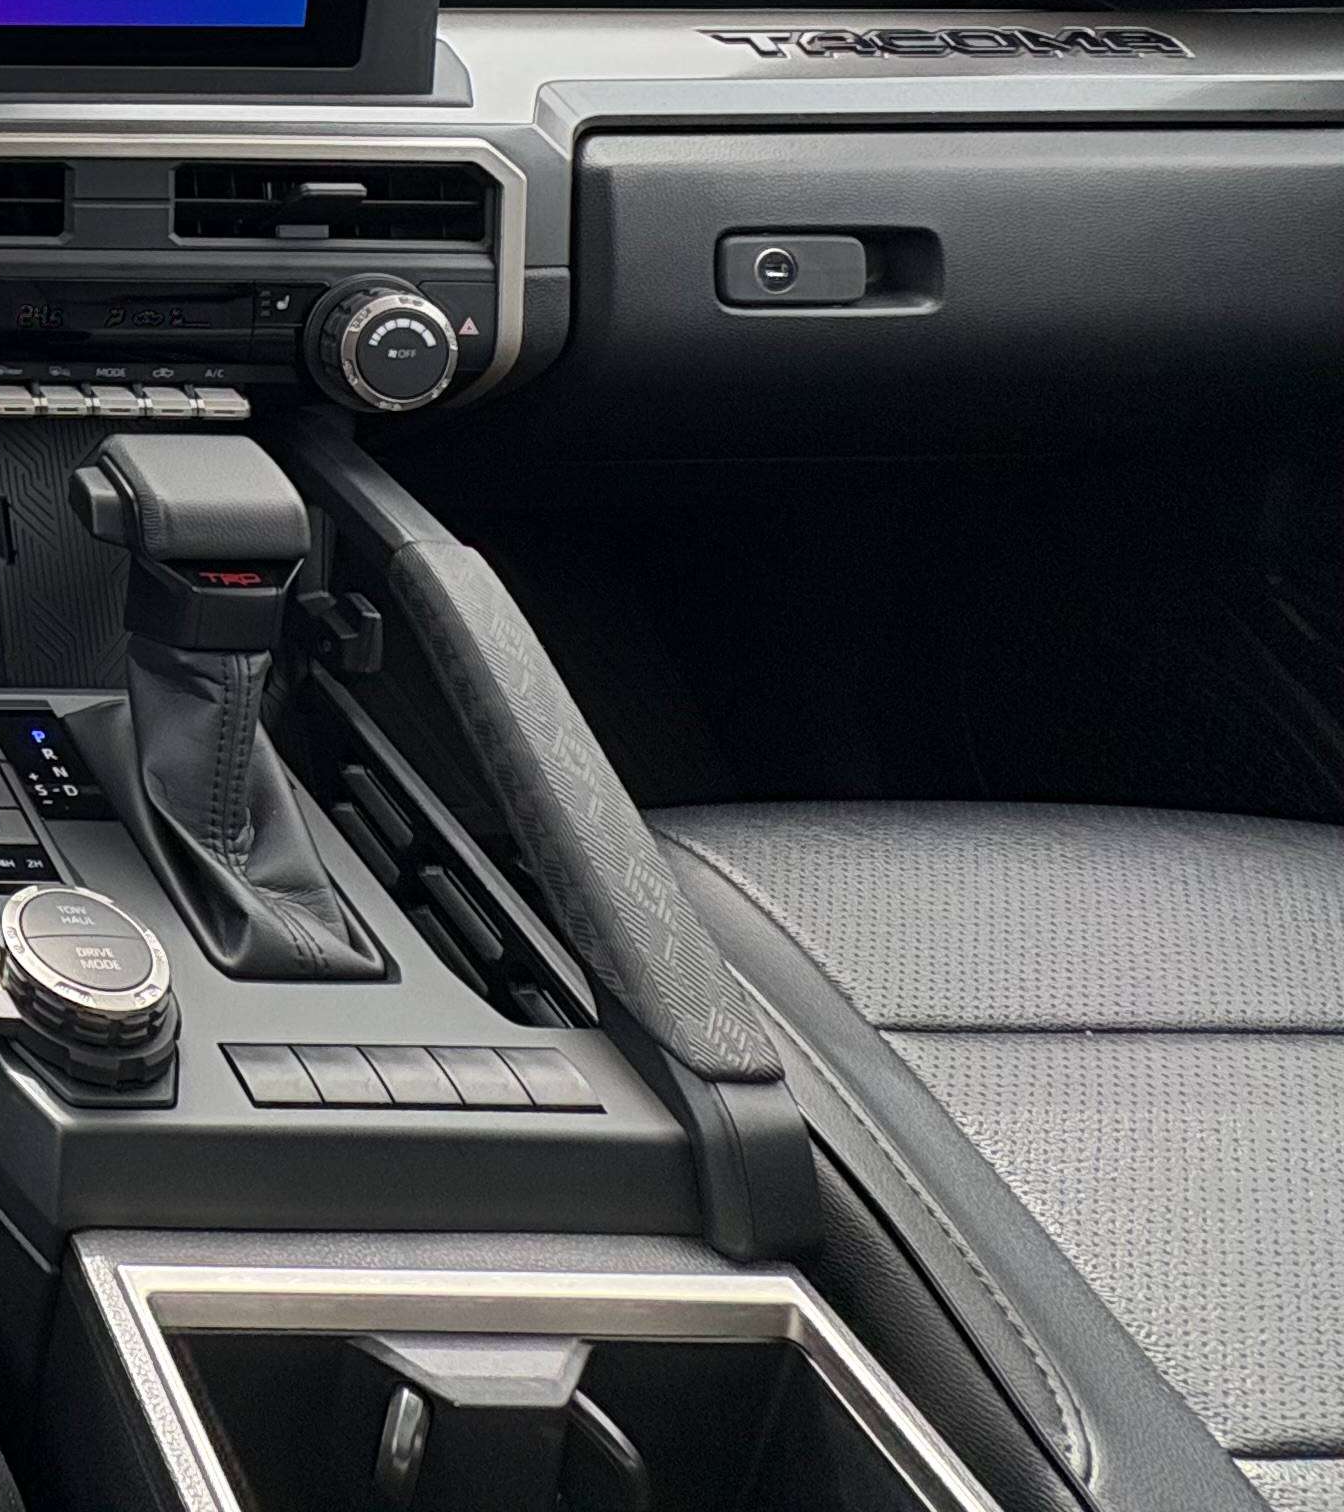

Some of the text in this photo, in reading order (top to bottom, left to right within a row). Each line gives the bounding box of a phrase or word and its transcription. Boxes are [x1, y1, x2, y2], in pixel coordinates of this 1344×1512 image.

[697, 26, 1196, 60] TACOMA
[398, 349, 417, 359] OFF
[95, 368, 127, 378] MODE
[204, 368, 225, 378] A/C
[199, 572, 263, 586] TRD
[31, 730, 46, 744] P
[41, 747, 58, 761] R
[51, 766, 69, 778] N
[25, 858, 44, 869] 2H
[60, 915, 95, 925] HAUL
[75, 946, 115, 958] DRIVE
[80, 958, 122, 970] MODE
